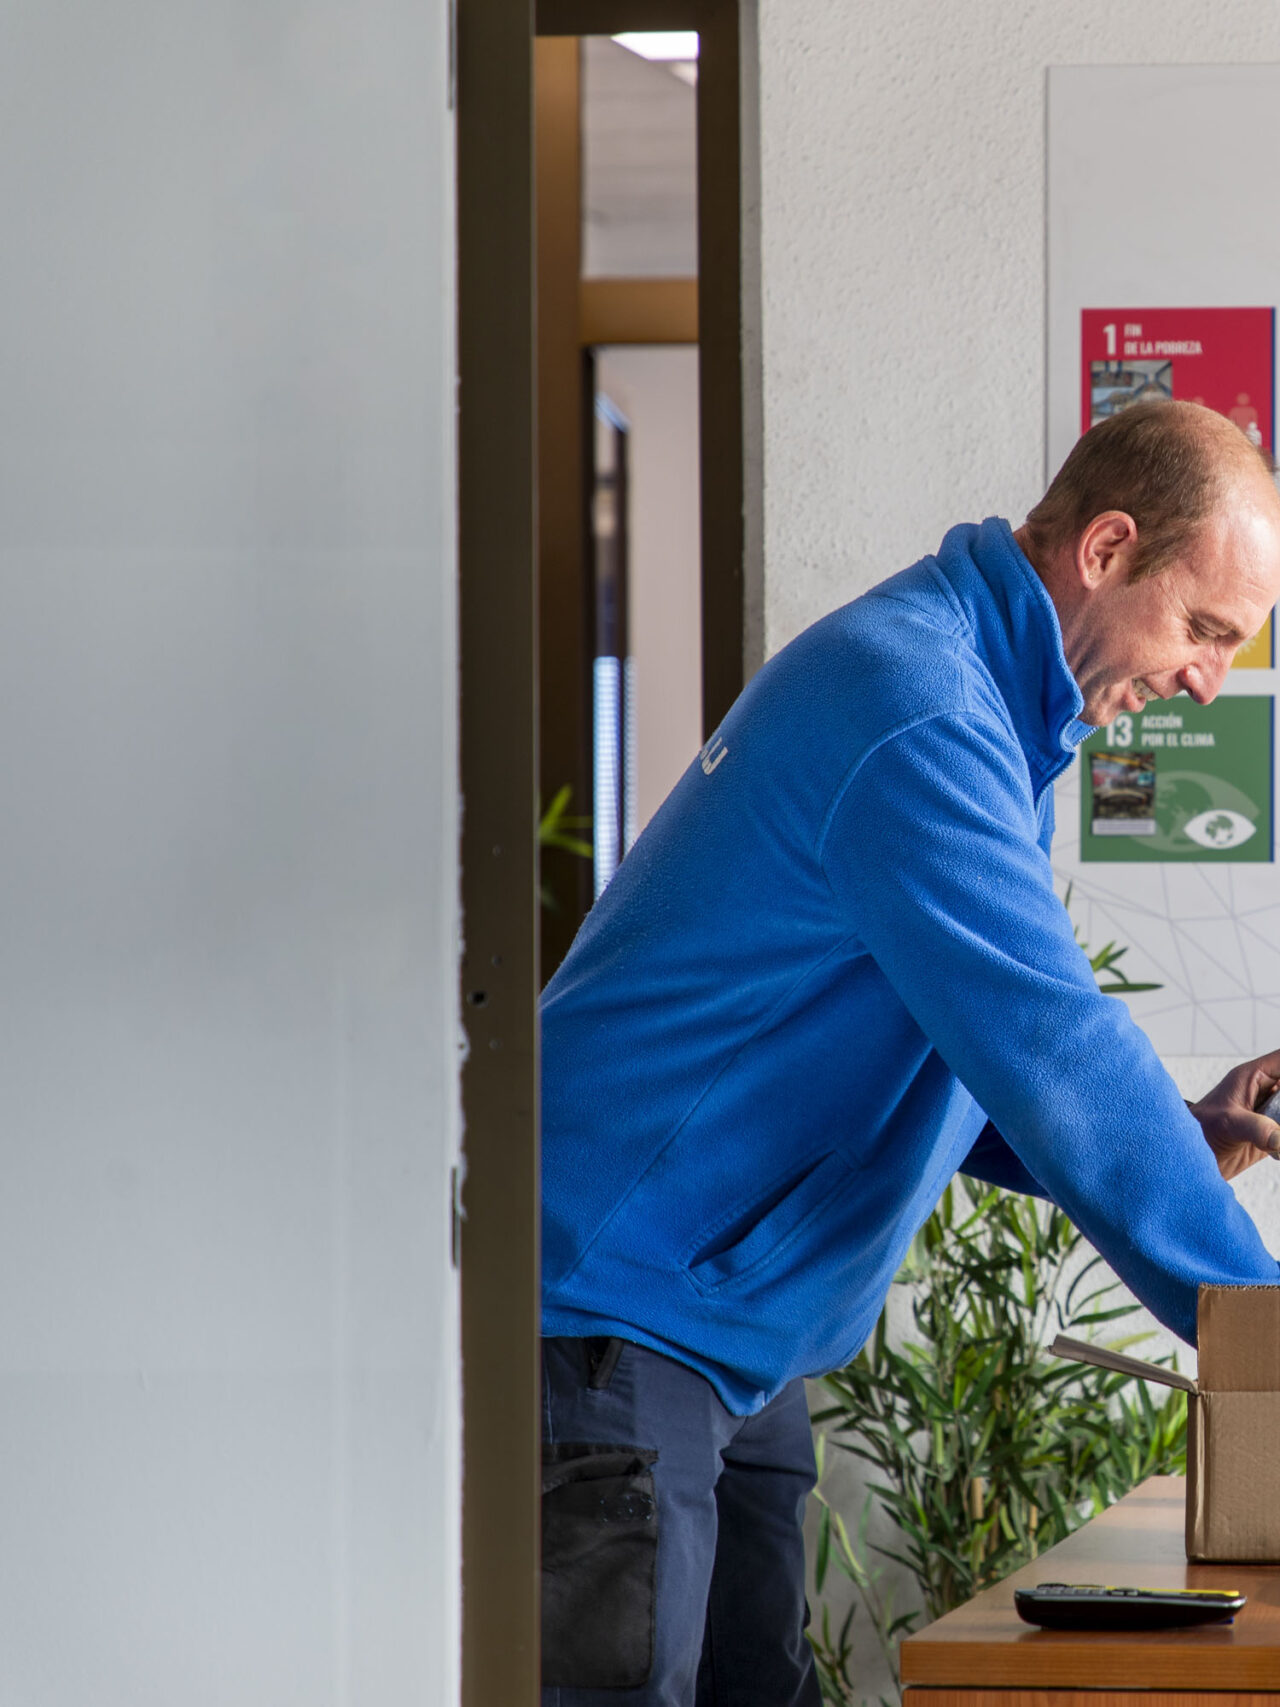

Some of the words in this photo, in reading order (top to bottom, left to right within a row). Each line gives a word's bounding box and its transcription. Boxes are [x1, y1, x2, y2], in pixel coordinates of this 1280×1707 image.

[1102, 323, 1117, 356] 1
[1139, 341, 1153, 355] LA
[1141, 711, 1183, 728] ACCIÓN
[1104, 715, 1133, 747] 13
[1141, 732, 1164, 747] POR
[1166, 732, 1179, 747] EL
[1180, 732, 1216, 747] CLIMA
